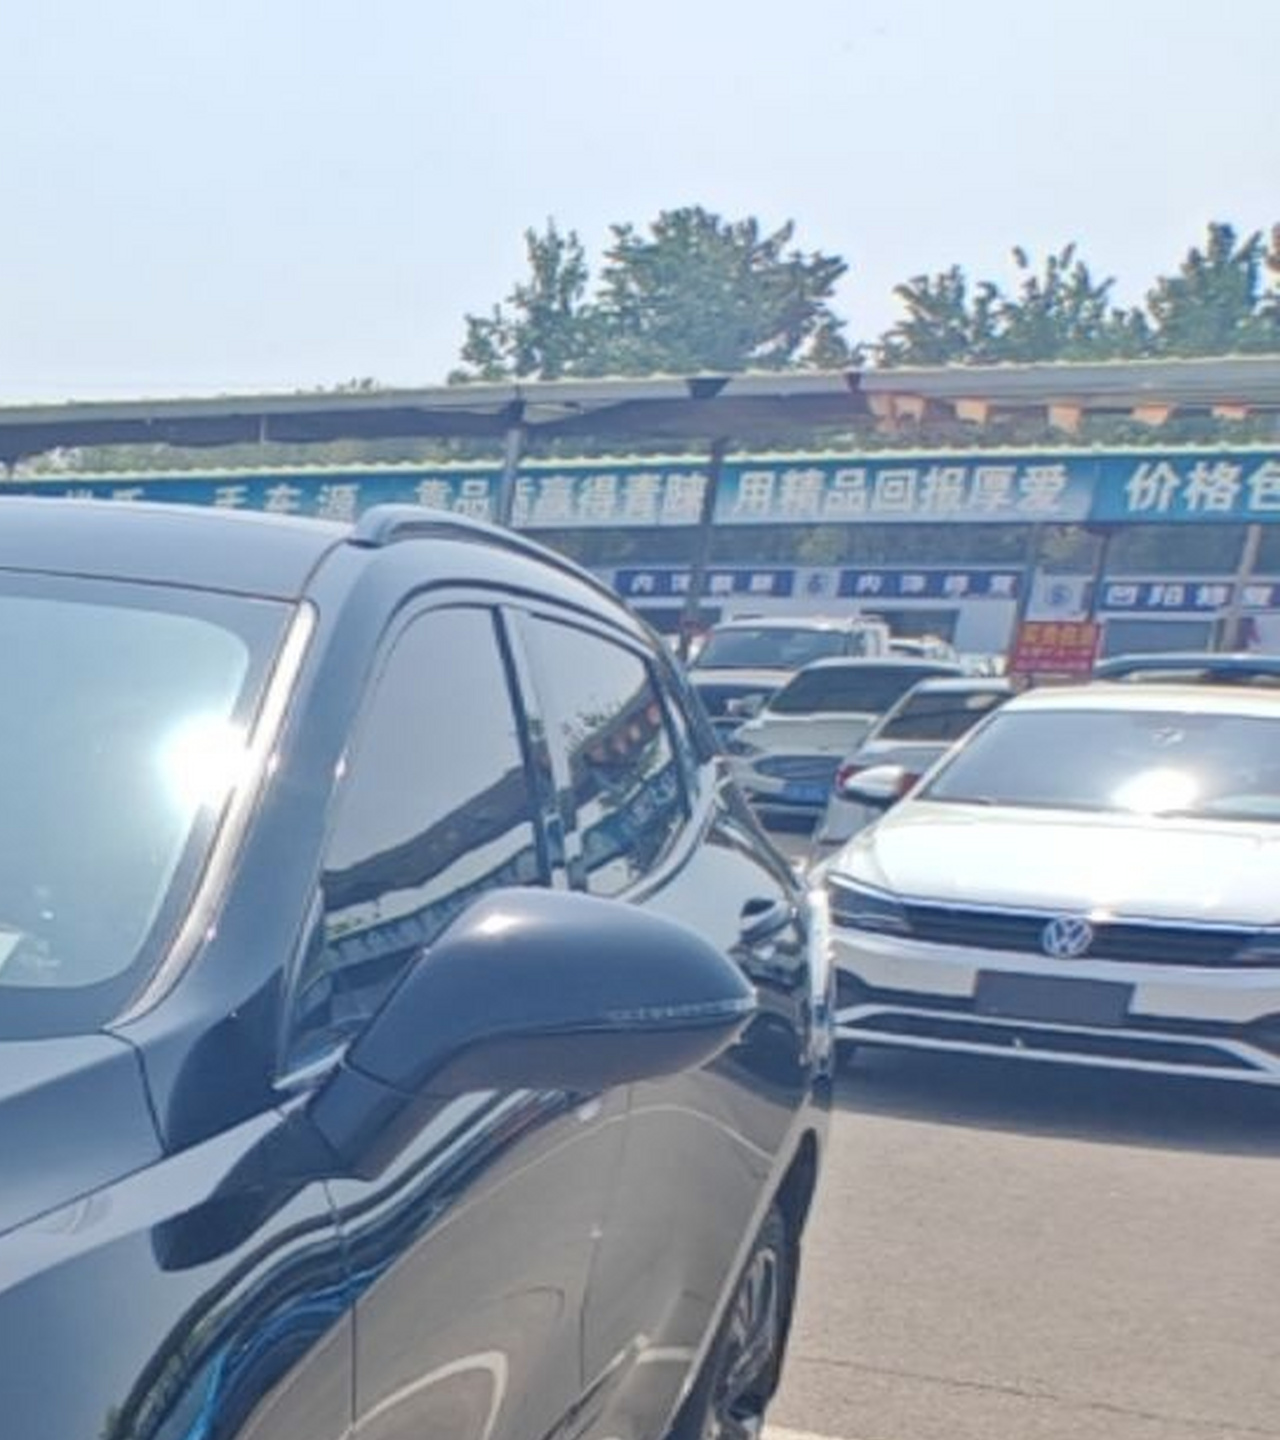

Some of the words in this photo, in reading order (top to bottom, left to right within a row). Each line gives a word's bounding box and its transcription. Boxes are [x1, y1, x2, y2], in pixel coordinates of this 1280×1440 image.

[734, 465, 1068, 514] 用精品回报厚爱
